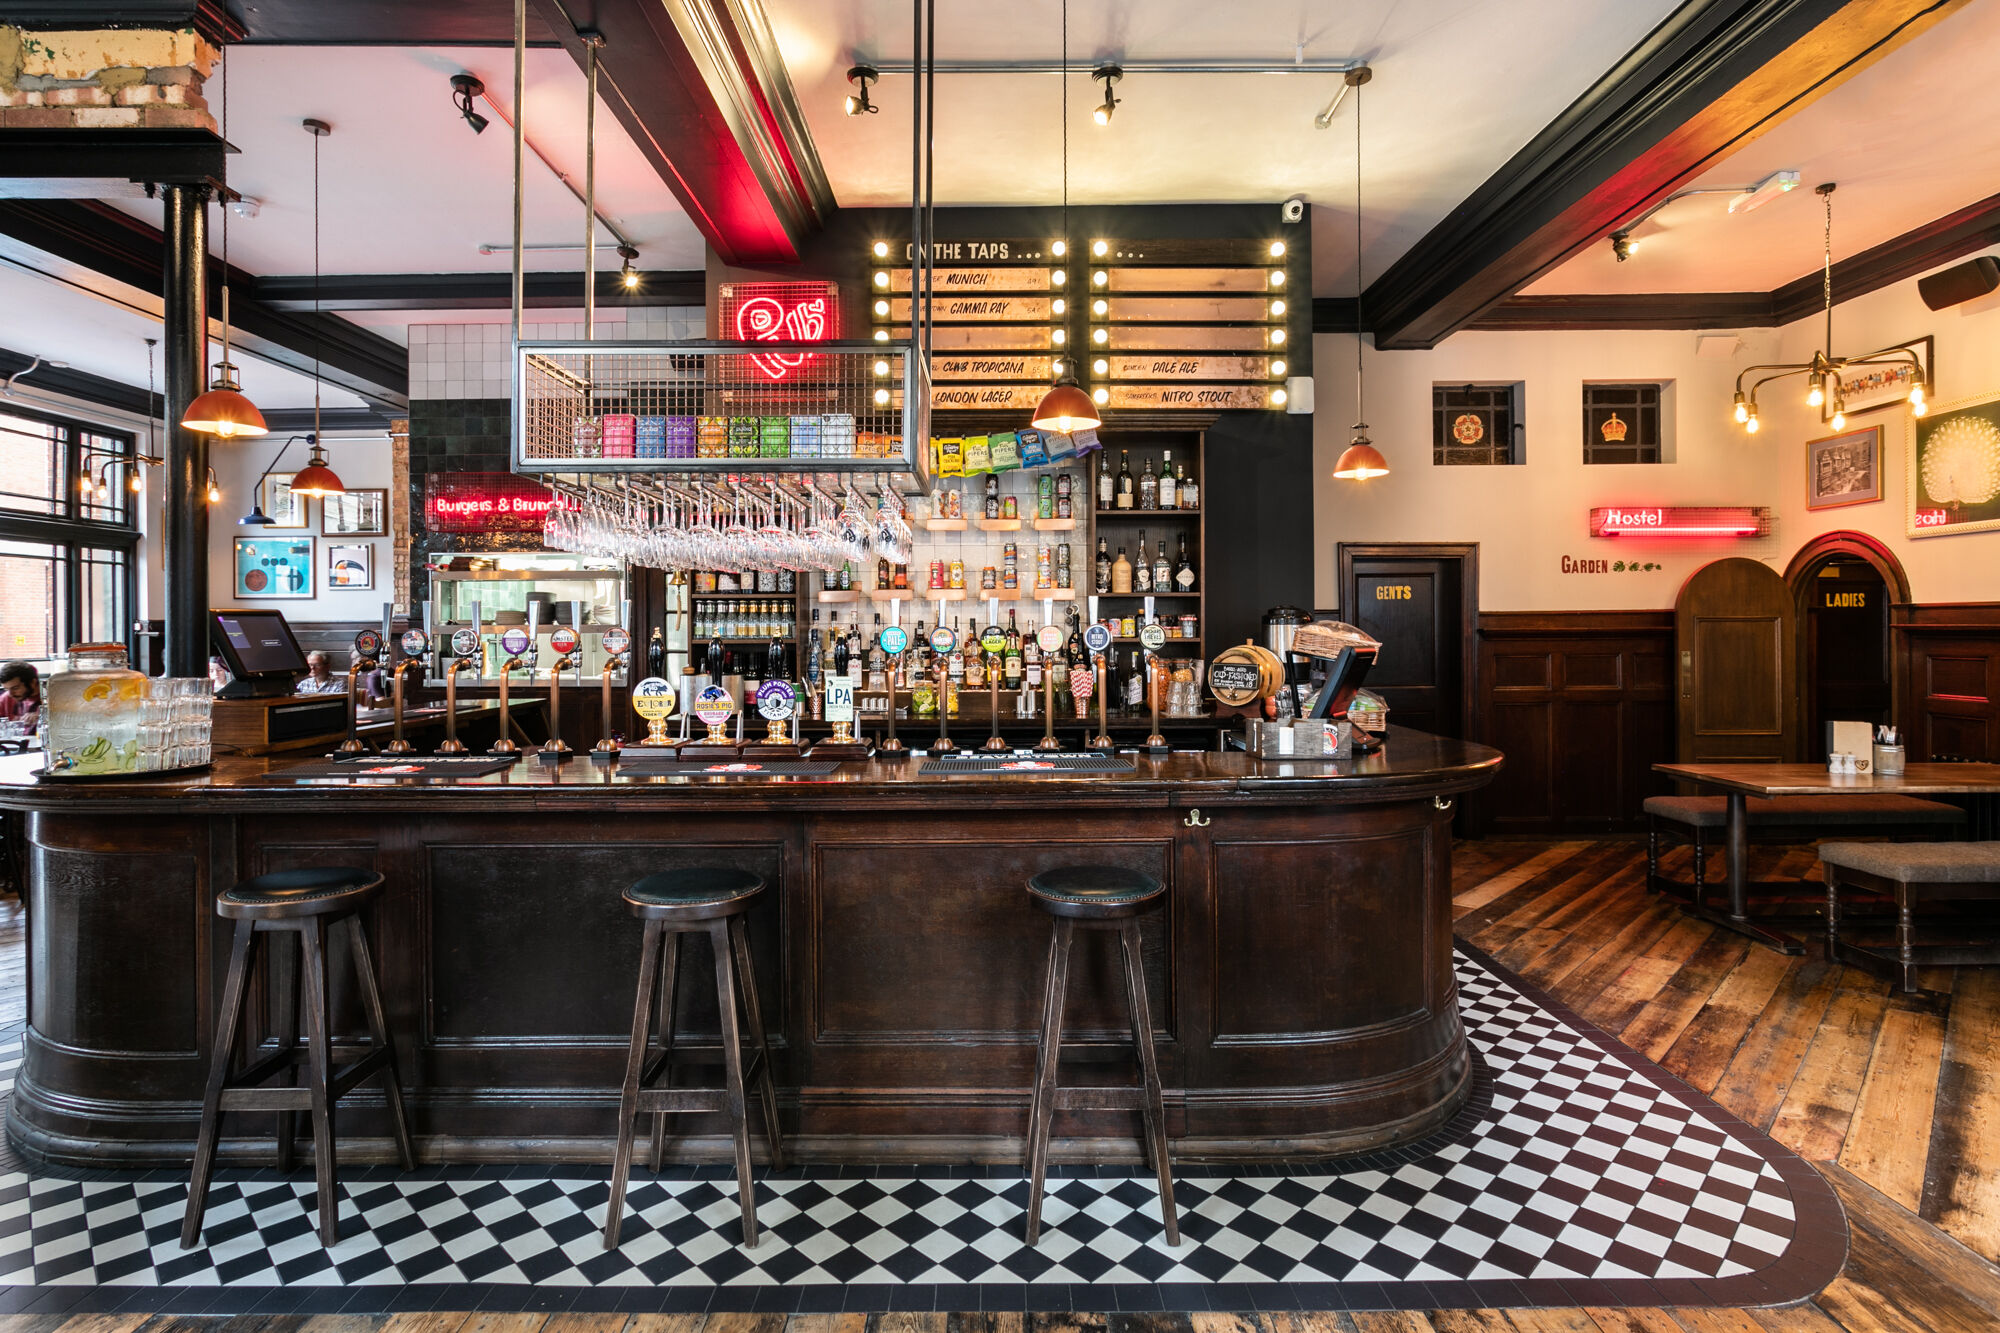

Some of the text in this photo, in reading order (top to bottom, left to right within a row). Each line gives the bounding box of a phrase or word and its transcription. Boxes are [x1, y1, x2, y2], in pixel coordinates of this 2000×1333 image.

[933, 243, 961, 260] THE
[968, 243, 1008, 260] TAPS
[946, 273, 989, 285] MUNICH
[950, 302, 987, 315] GAMMA
[989, 301, 1009, 314] RAY
[971, 361, 1025, 374] TROPICANA
[1152, 362, 1177, 373] PALE
[1178, 362, 1199, 373] ALE
[934, 391, 1013, 404] LONDON LAGER
[1161, 391, 1194, 403] NITRO
[1197, 391, 1233, 403] STOUT
[437, 498, 492, 515] Burgers
[498, 497, 510, 512] &
[1606, 508, 1663, 526] Hostel
[1376, 585, 1412, 600] GENTS
[1826, 592, 1865, 607] LADIES
[887, 635, 901, 646] PALE
[758, 682, 772, 697] PLUM
[773, 680, 795, 697] PORTER
[826, 688, 852, 704] LPA
[762, 708, 789, 717] TITANIC
